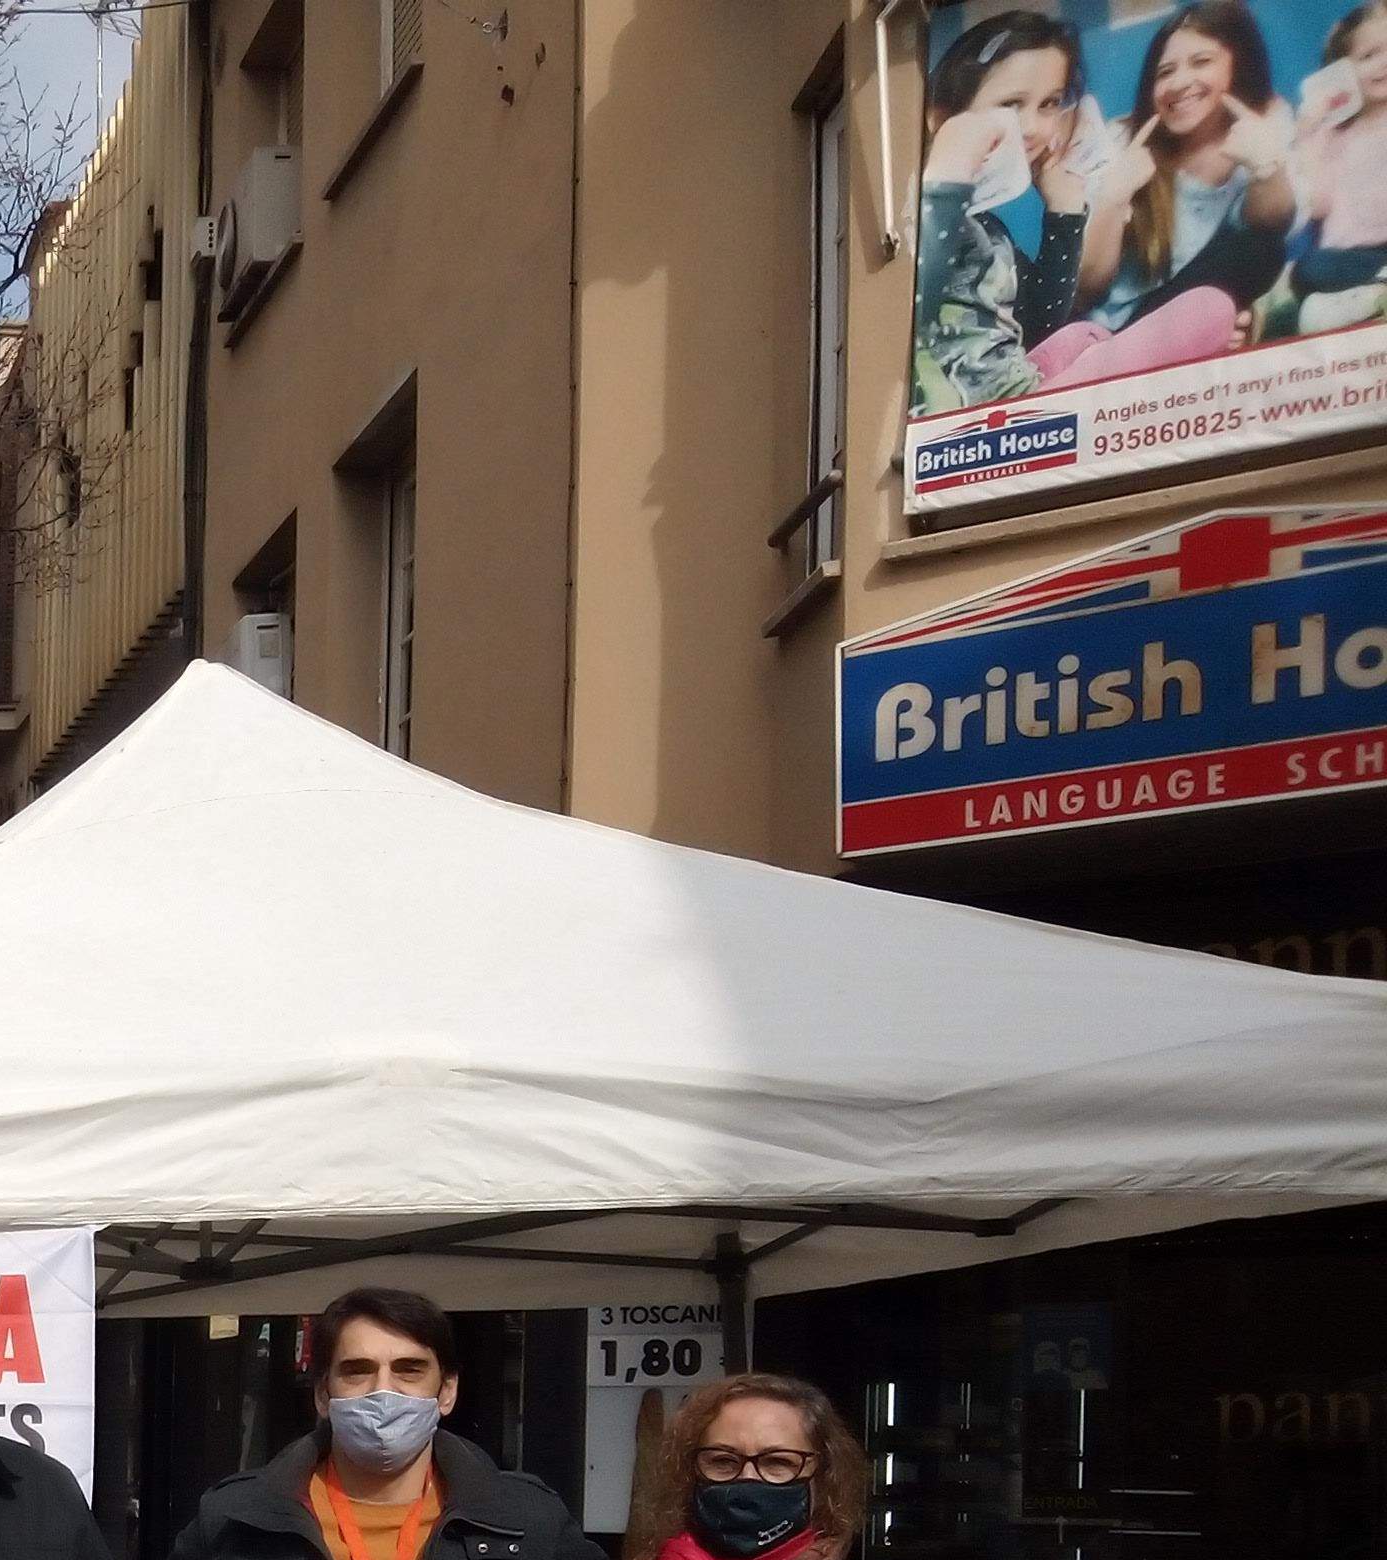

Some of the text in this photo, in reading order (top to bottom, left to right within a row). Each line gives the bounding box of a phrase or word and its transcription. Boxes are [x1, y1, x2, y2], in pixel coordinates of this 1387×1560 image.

[1093, 400, 1159, 424] Anglès
[1164, 393, 1198, 411] des
[1237, 374, 1273, 397] any
[1277, 371, 1284, 387] i
[1288, 363, 1325, 384] fins
[1331, 357, 1361, 376] les
[917, 426, 1075, 474] British House
[874, 612, 1387, 764] British Ho
[964, 741, 1385, 829] LANGUAGE SCH
[600, 1306, 614, 1326] 3
[600, 1338, 702, 1384] 1,80
